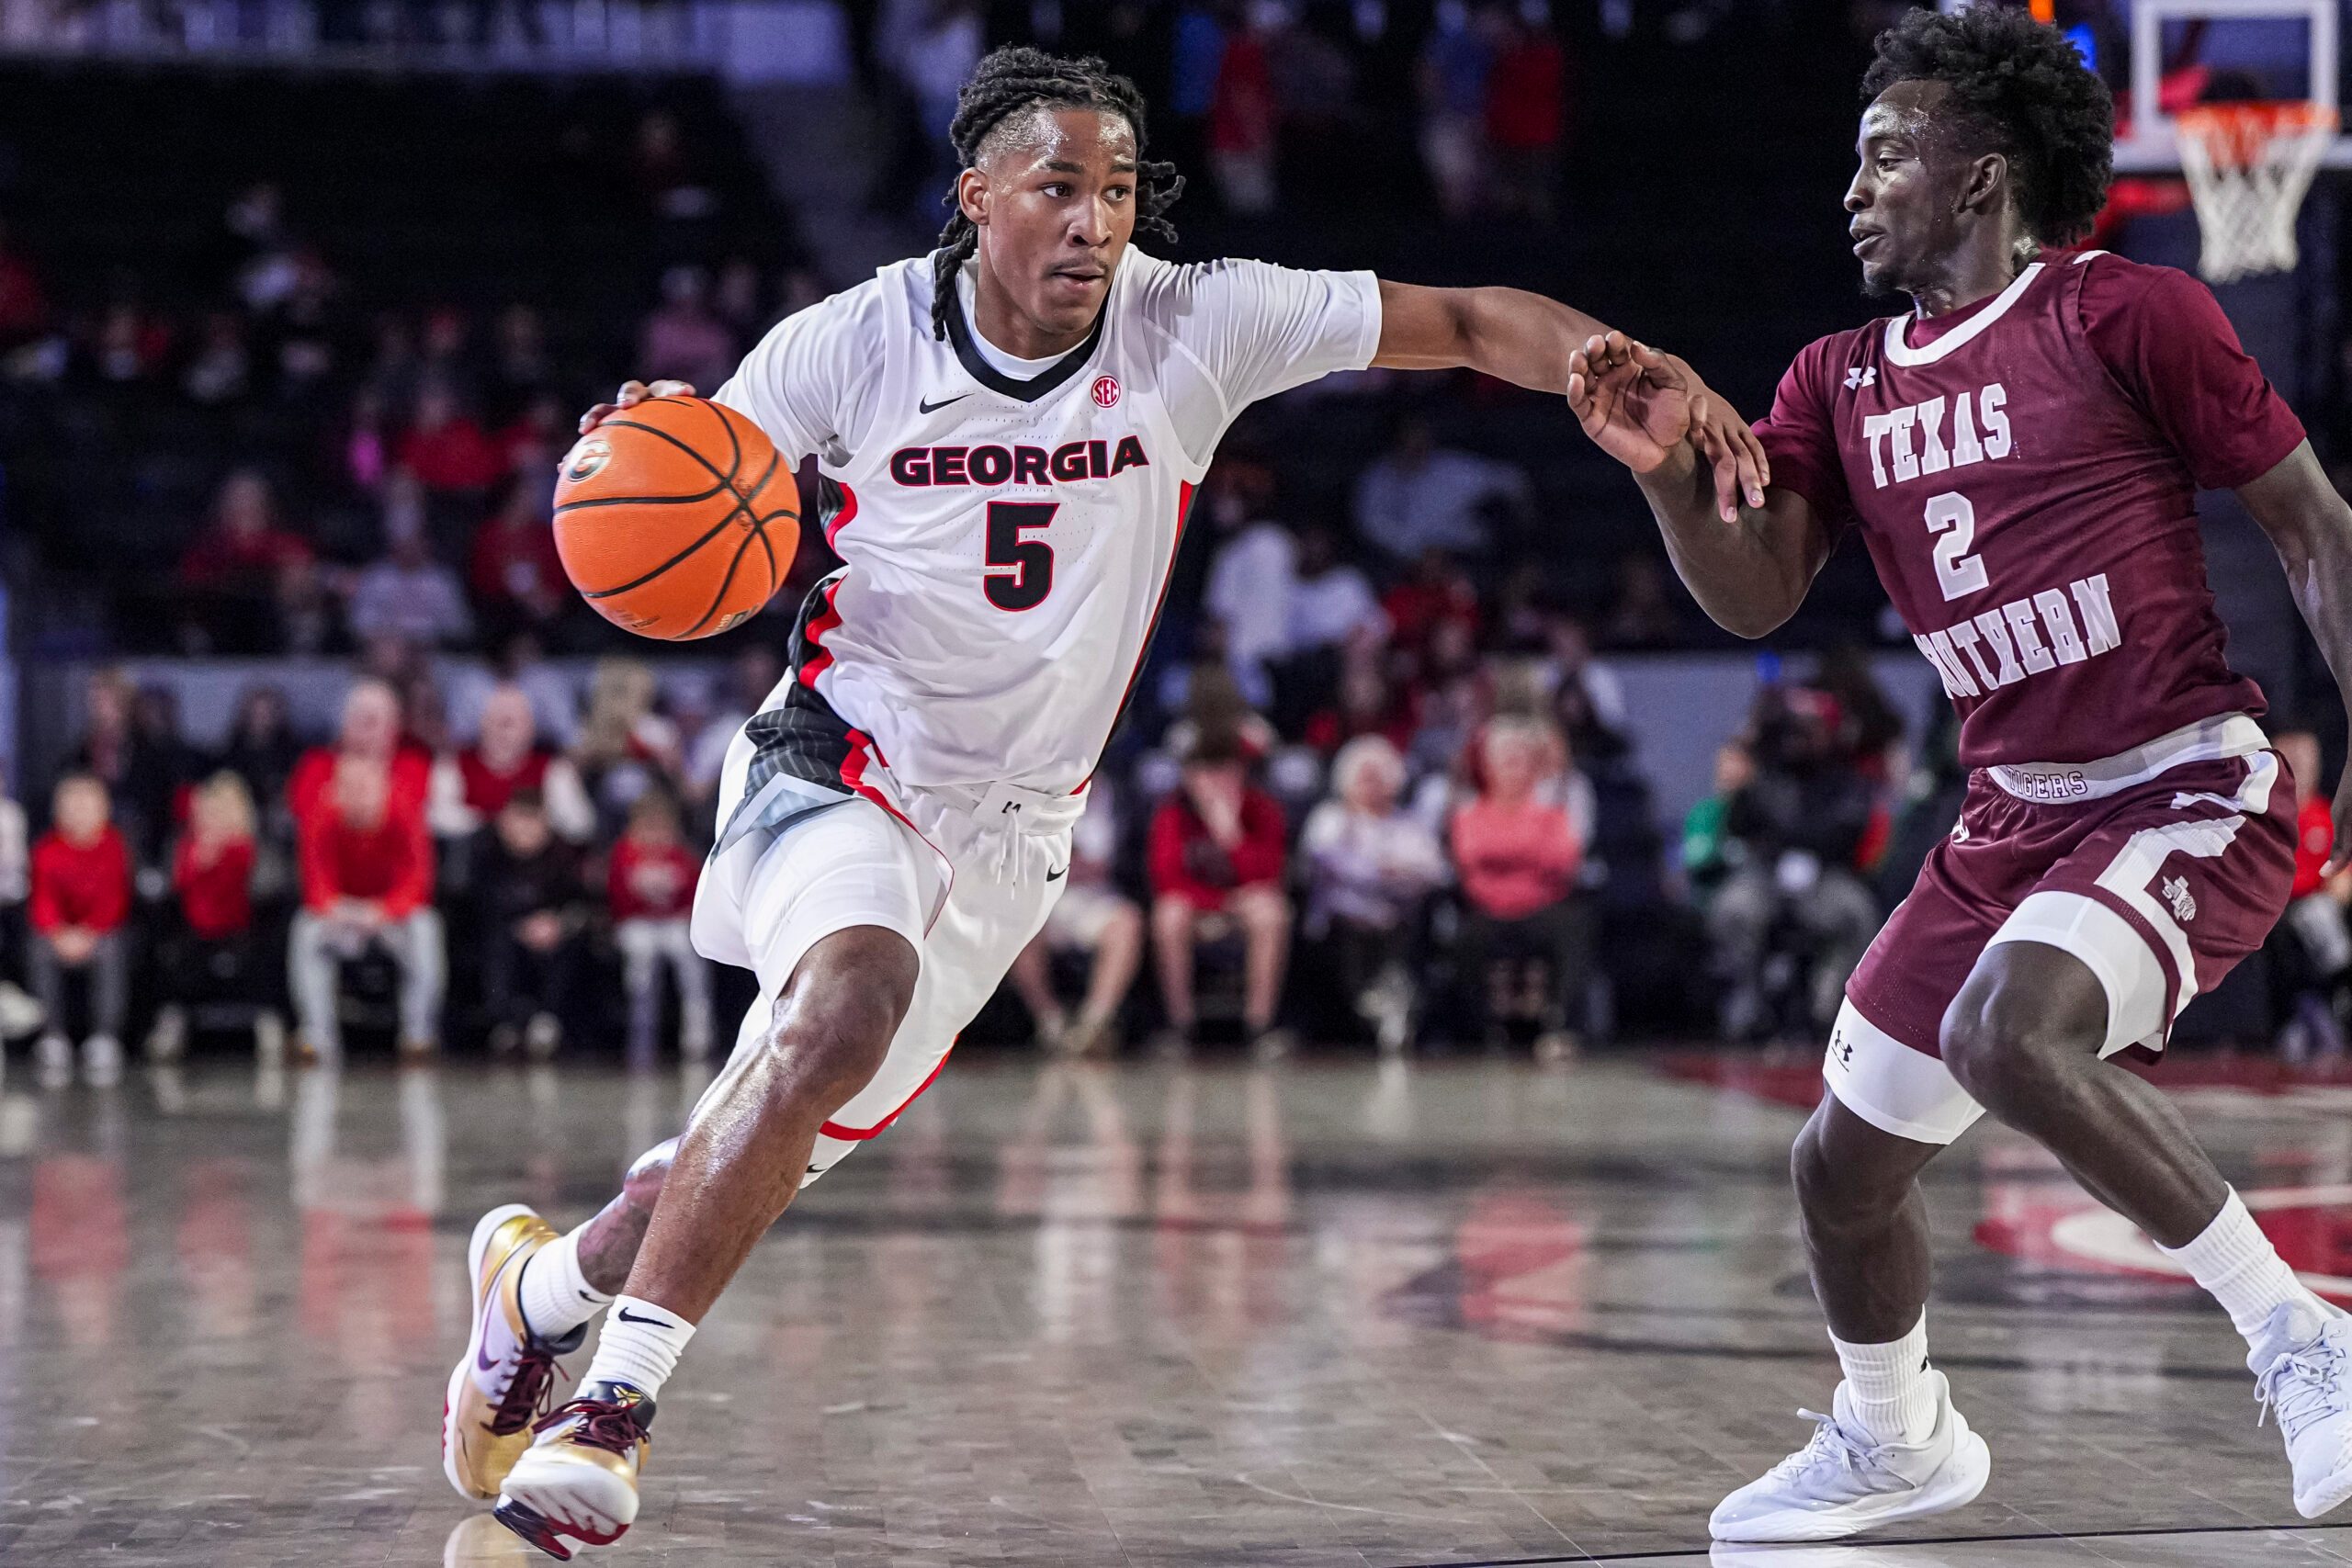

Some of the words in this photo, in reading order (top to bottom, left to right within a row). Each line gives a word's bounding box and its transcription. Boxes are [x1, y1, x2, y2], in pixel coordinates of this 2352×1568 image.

[1093, 378, 1118, 405] SEC
[889, 435, 1150, 487] GEORGIA
[1862, 383, 2012, 490] TEXAS
[983, 501, 1060, 612] 5
[1924, 491, 1989, 602] 2
[2006, 765, 2088, 799] TIGERS
